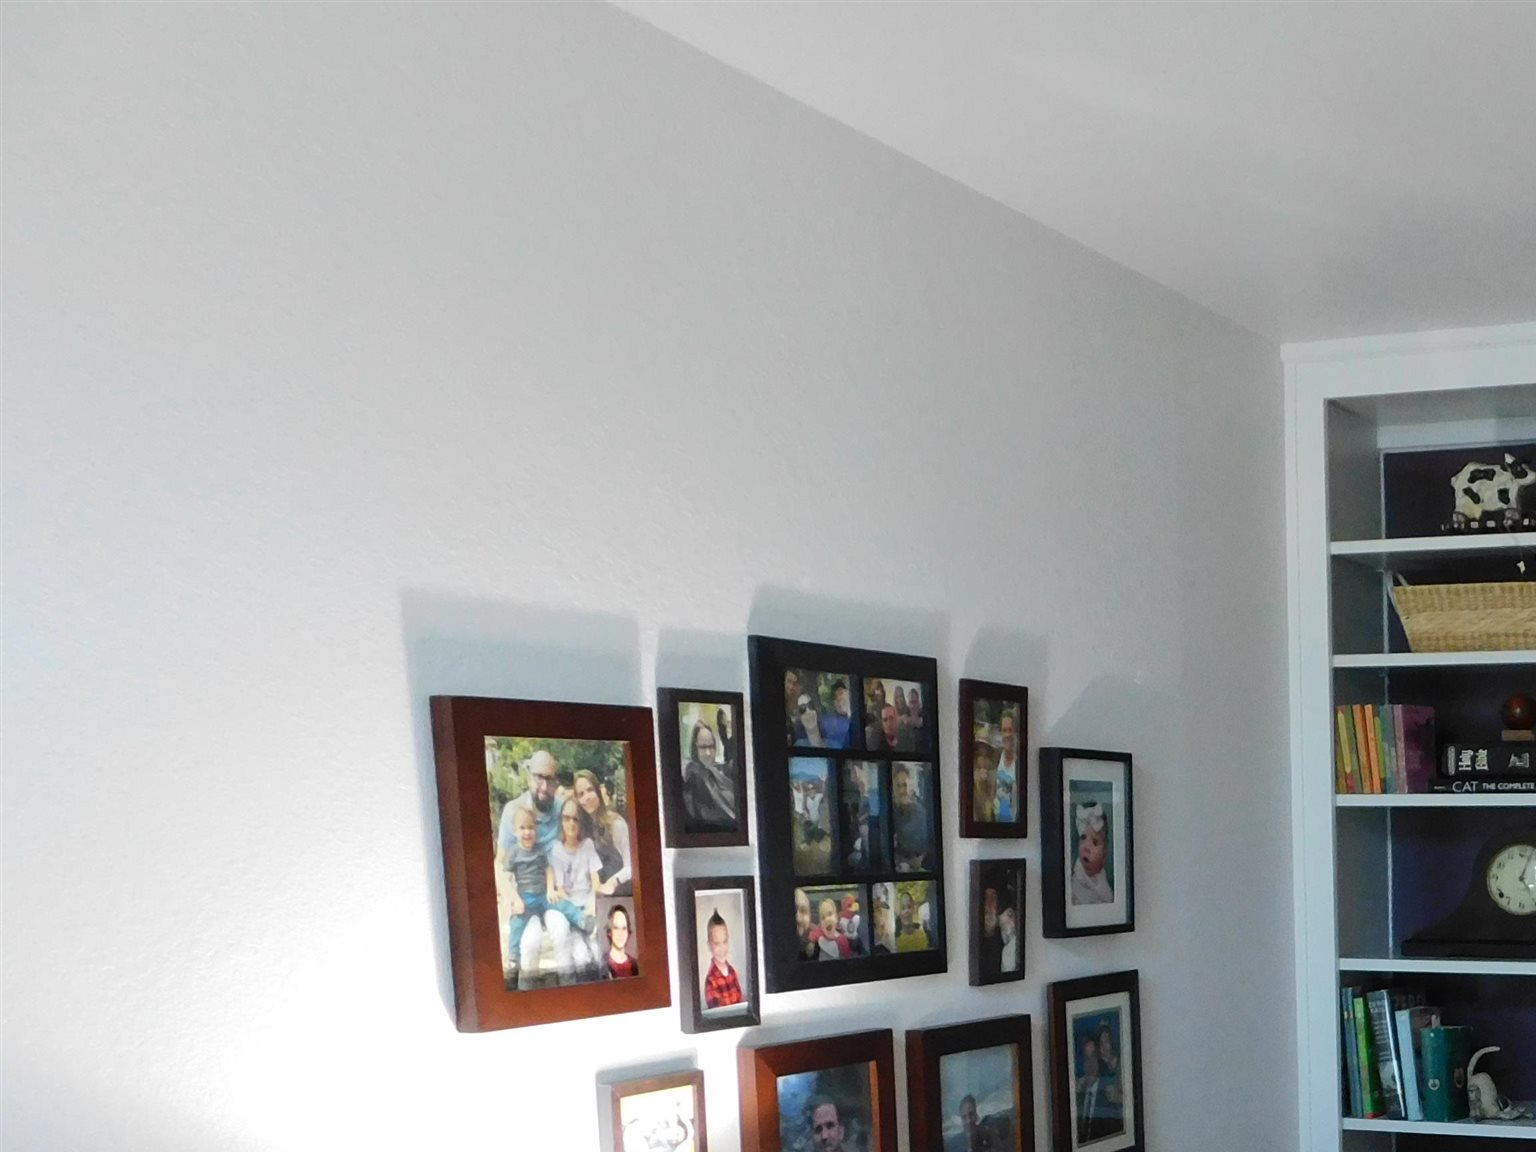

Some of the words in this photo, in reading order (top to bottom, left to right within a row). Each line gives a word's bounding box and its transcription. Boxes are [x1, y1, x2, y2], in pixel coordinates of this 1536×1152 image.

[1458, 749, 1474, 770] Holy
[1452, 781, 1479, 793] CAT
[1482, 782, 1496, 790] THE
[1497, 782, 1535, 790] COMPLETE
